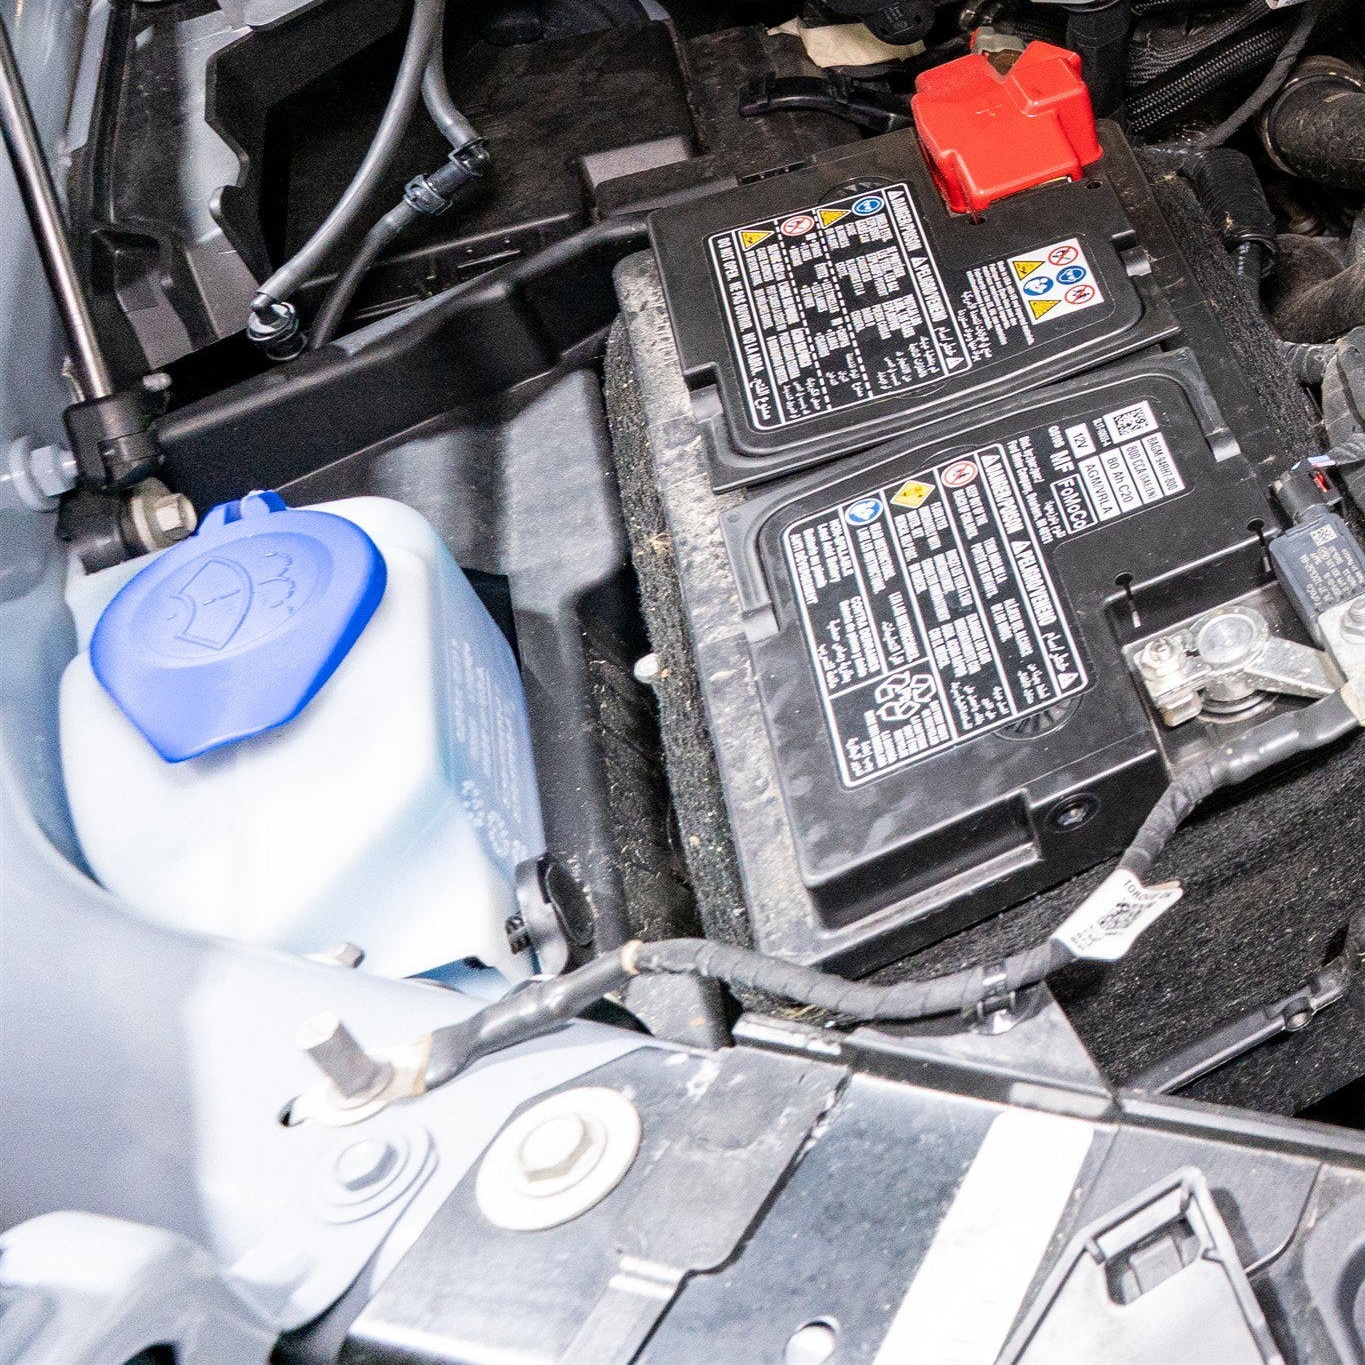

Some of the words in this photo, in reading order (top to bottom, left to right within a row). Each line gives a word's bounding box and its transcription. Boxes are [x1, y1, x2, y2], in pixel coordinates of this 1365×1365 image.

[1072, 432, 1088, 450] 12V
[1125, 444, 1140, 460] 800
[1049, 449, 1074, 476] MF
[1106, 456, 1119, 470] 80
[1131, 458, 1146, 475] CCA
[1112, 469, 1125, 484] Ah
[1084, 462, 1113, 514] AGM/VRLA
[1117, 483, 1133, 503] C20
[1057, 477, 1089, 529] FoMoCo
[983, 461, 1024, 535] DANGER/POISON
[1014, 548, 1058, 628] PELIGRO/VENENO
